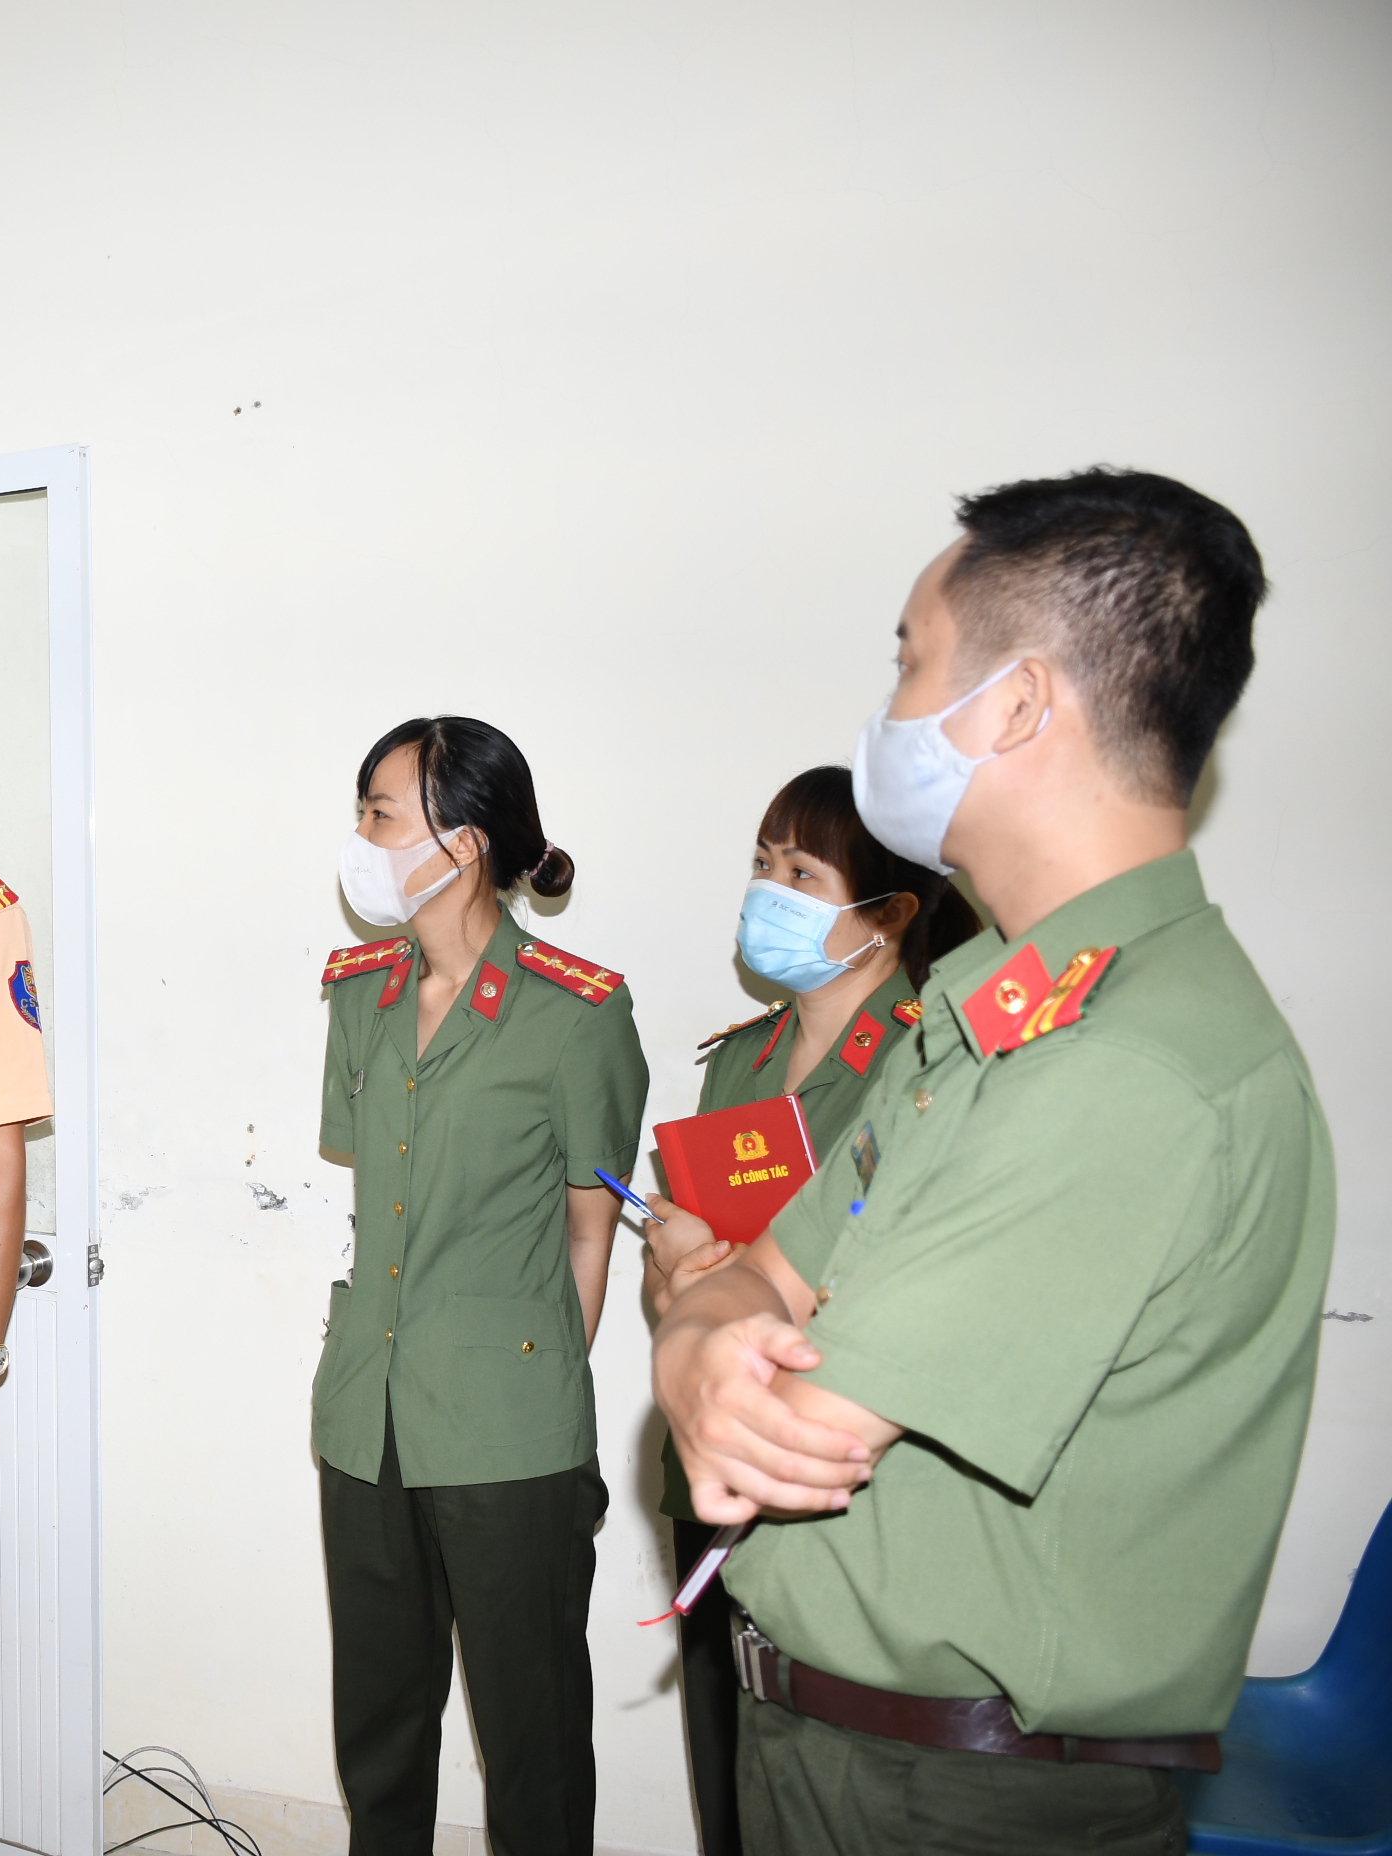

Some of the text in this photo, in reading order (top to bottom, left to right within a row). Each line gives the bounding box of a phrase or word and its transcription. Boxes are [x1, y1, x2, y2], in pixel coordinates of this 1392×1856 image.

[728, 1164, 789, 1187] SỔ CÔNG TÁC
